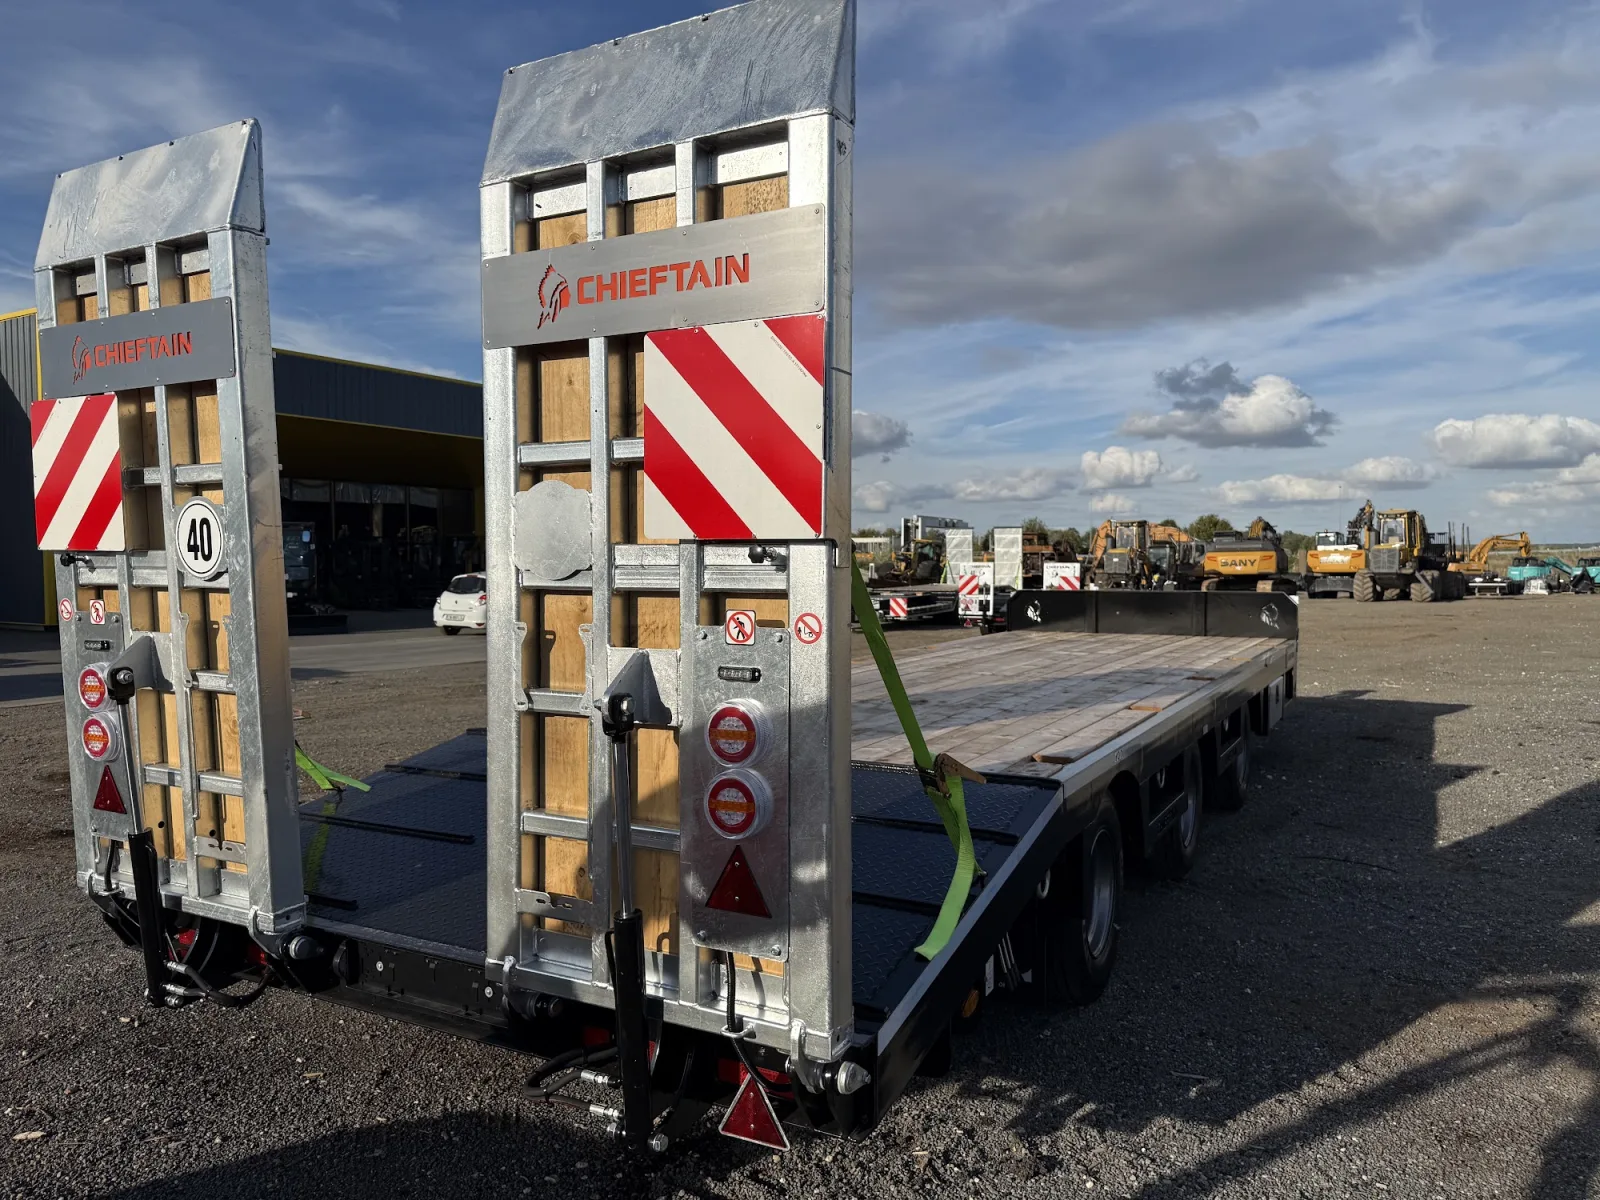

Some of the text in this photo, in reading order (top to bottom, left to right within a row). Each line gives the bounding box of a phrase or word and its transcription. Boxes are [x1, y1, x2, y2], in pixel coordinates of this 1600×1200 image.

[577, 253, 749, 304] CHIEFTAIN
[94, 331, 192, 367] CHIEFTAIN
[187, 517, 212, 562] 40
[1220, 558, 1257, 567] SANY
